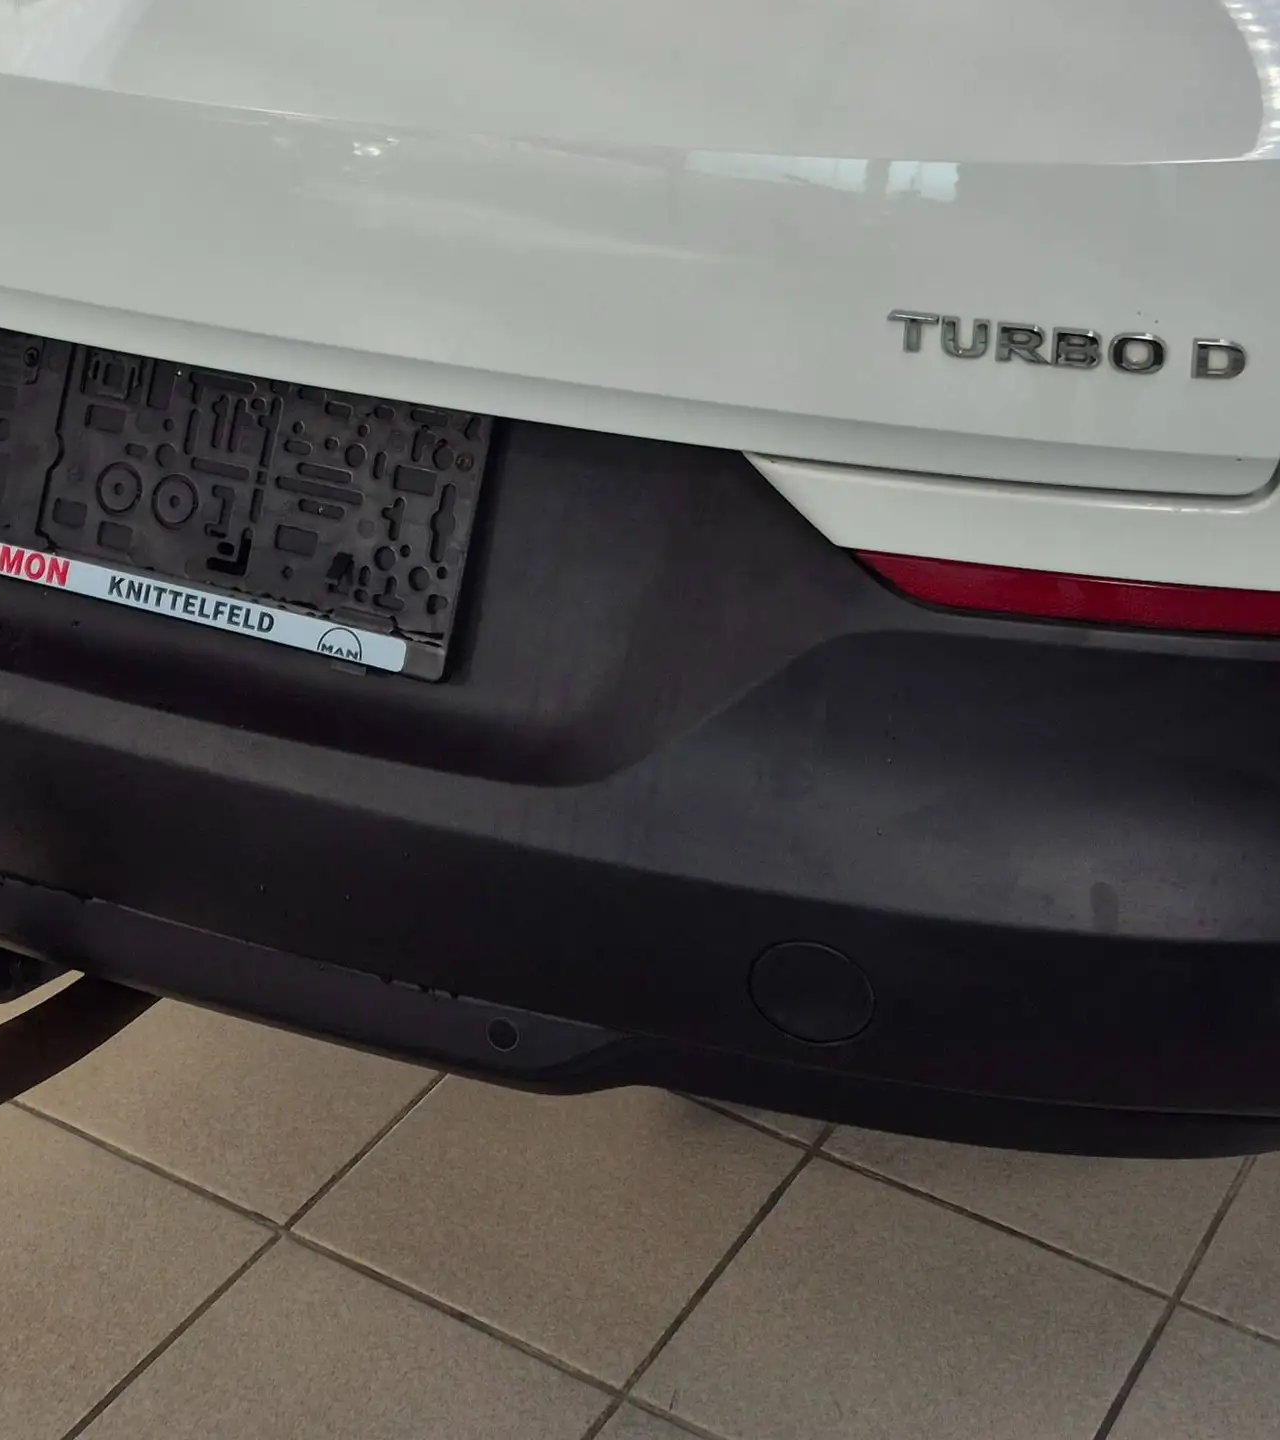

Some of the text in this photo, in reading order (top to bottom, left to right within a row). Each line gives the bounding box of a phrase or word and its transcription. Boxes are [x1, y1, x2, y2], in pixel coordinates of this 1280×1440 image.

[887, 309, 1248, 379] TURBO D
[107, 574, 276, 634] KNITTELFELD
[320, 641, 360, 661] MAN
